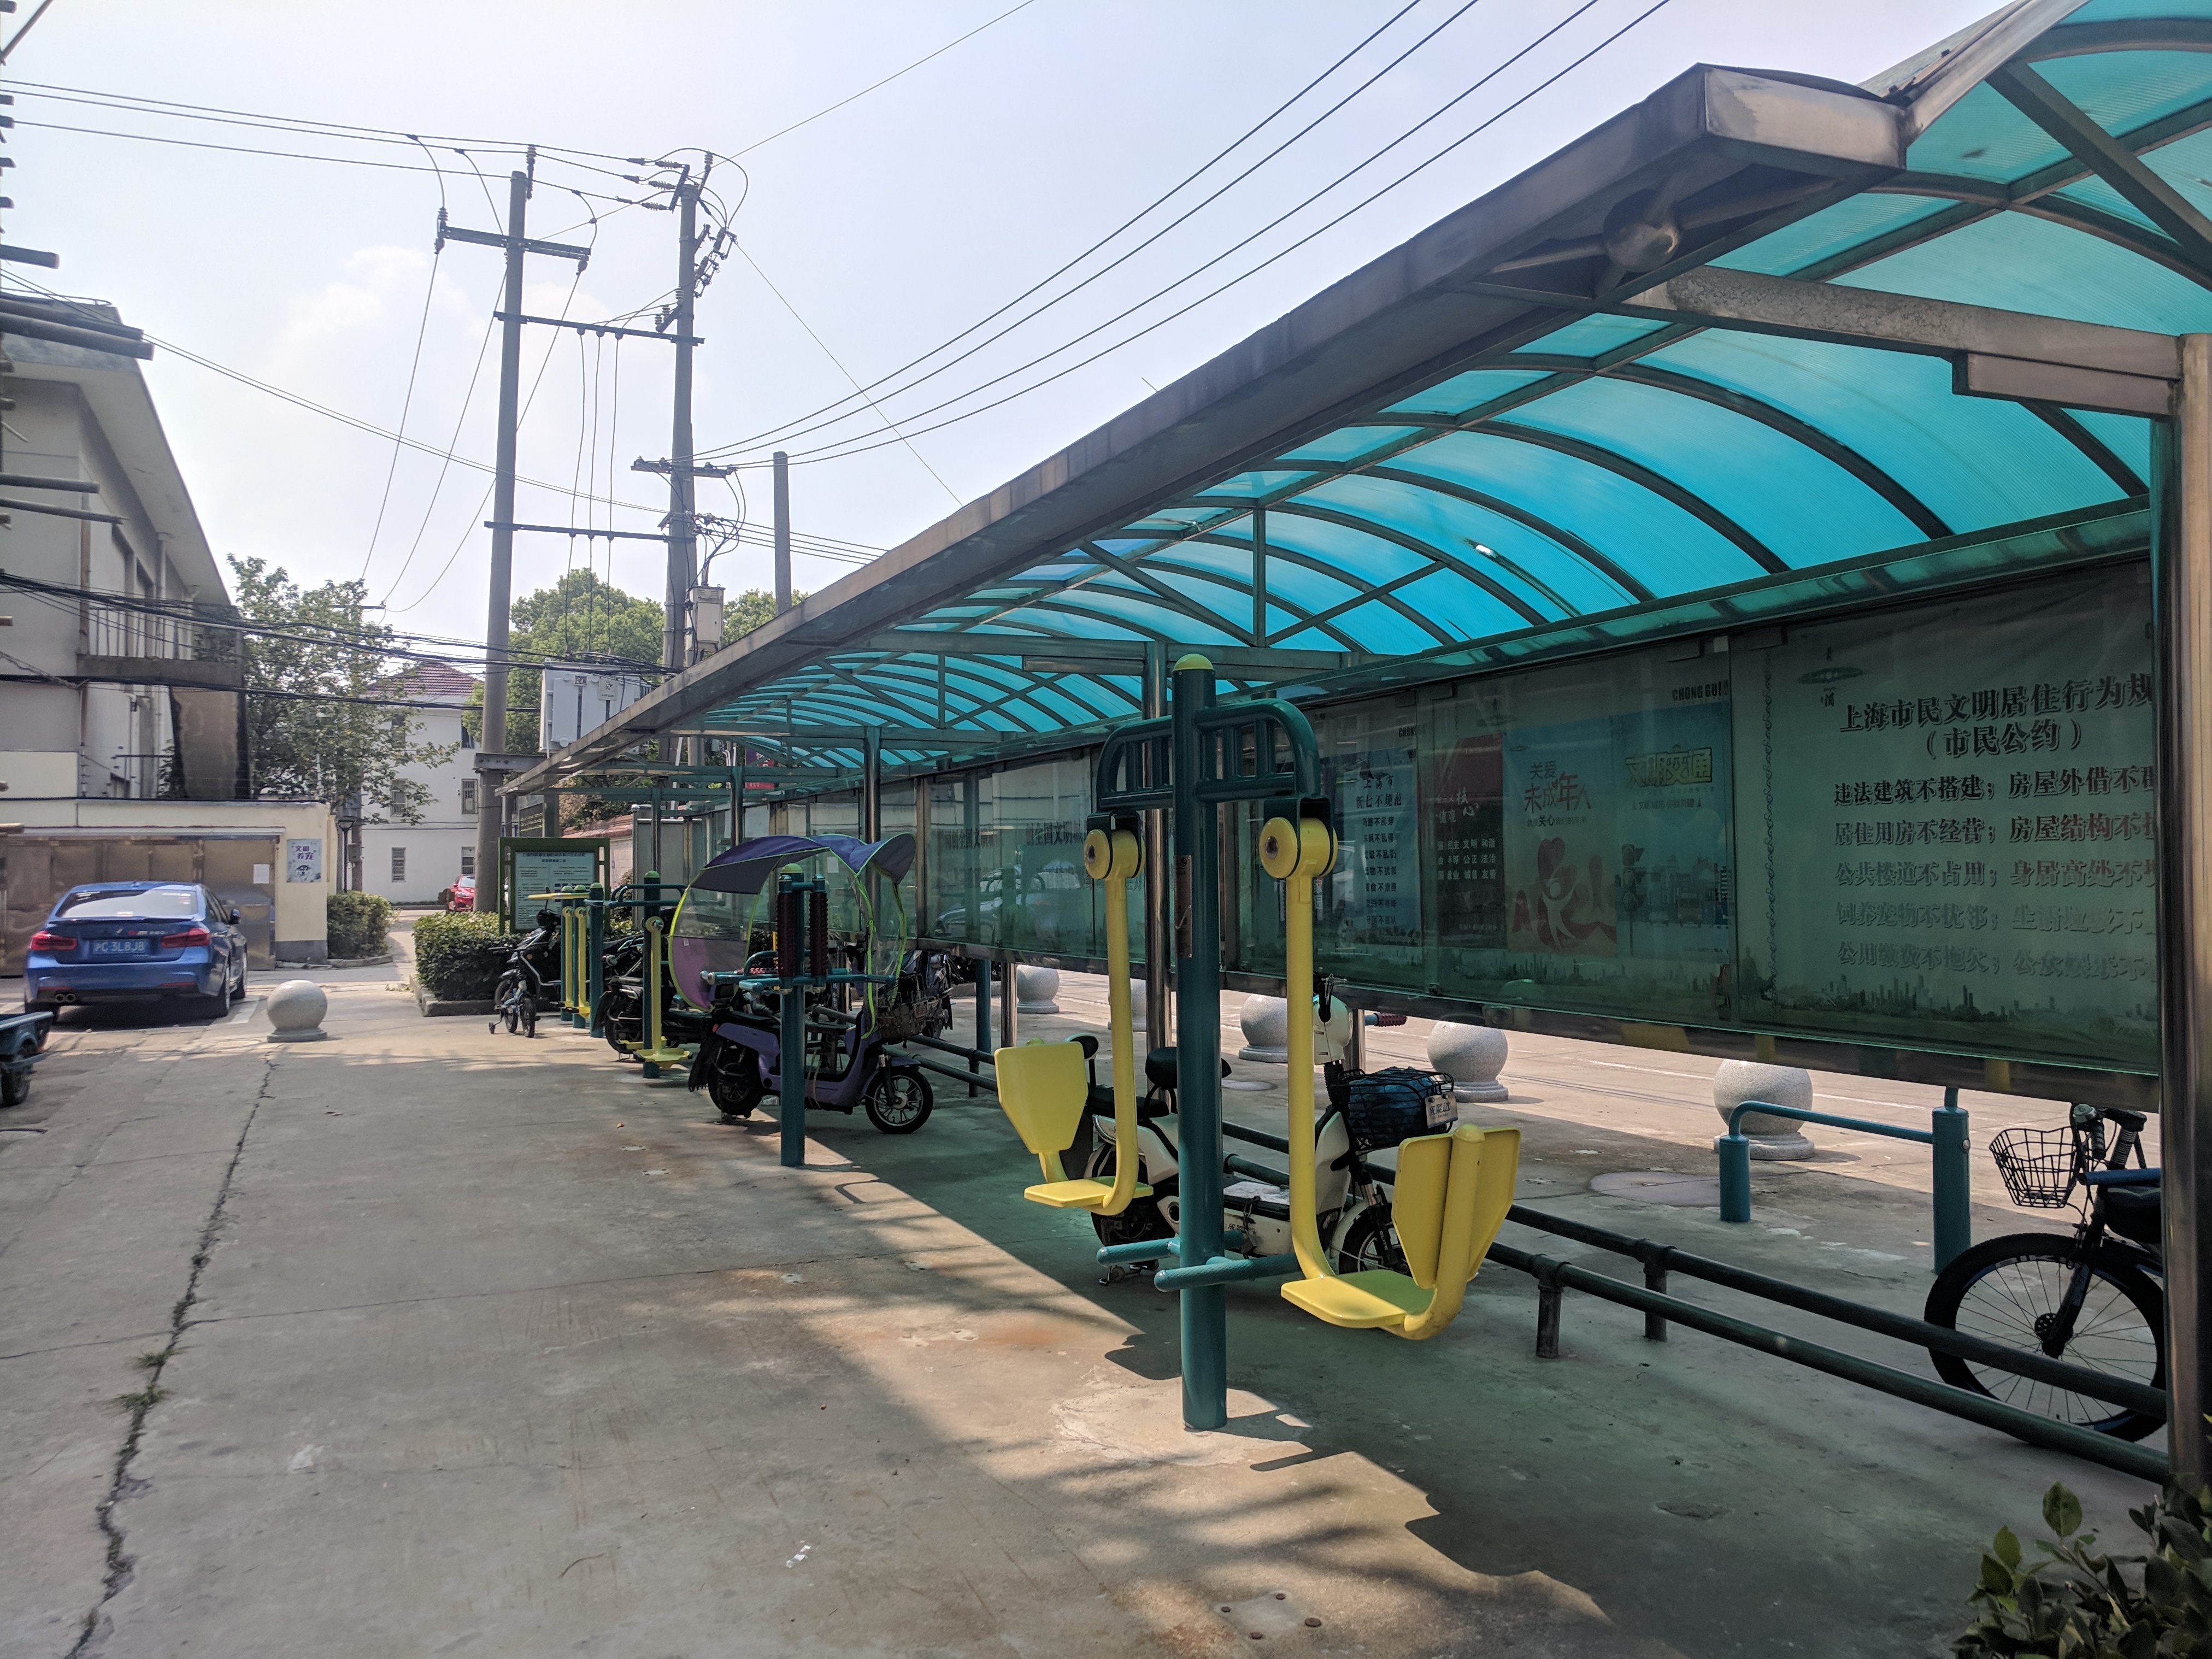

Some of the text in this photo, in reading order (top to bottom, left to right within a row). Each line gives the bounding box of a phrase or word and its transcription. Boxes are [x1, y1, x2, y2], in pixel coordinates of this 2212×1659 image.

[1673, 685, 1703, 701] CHONG
[1529, 760, 1557, 780] 关爱
[1625, 745, 1713, 789] 文明交通
[1524, 770, 1592, 814] 未成年人
[1833, 774, 1996, 807] 违法建筑不搭建；
[1834, 819, 1996, 846] 居住用房不经营；
[1835, 861, 1998, 887] 公共楼道不占用；
[2013, 948, 2156, 983] 公众娱乐不
